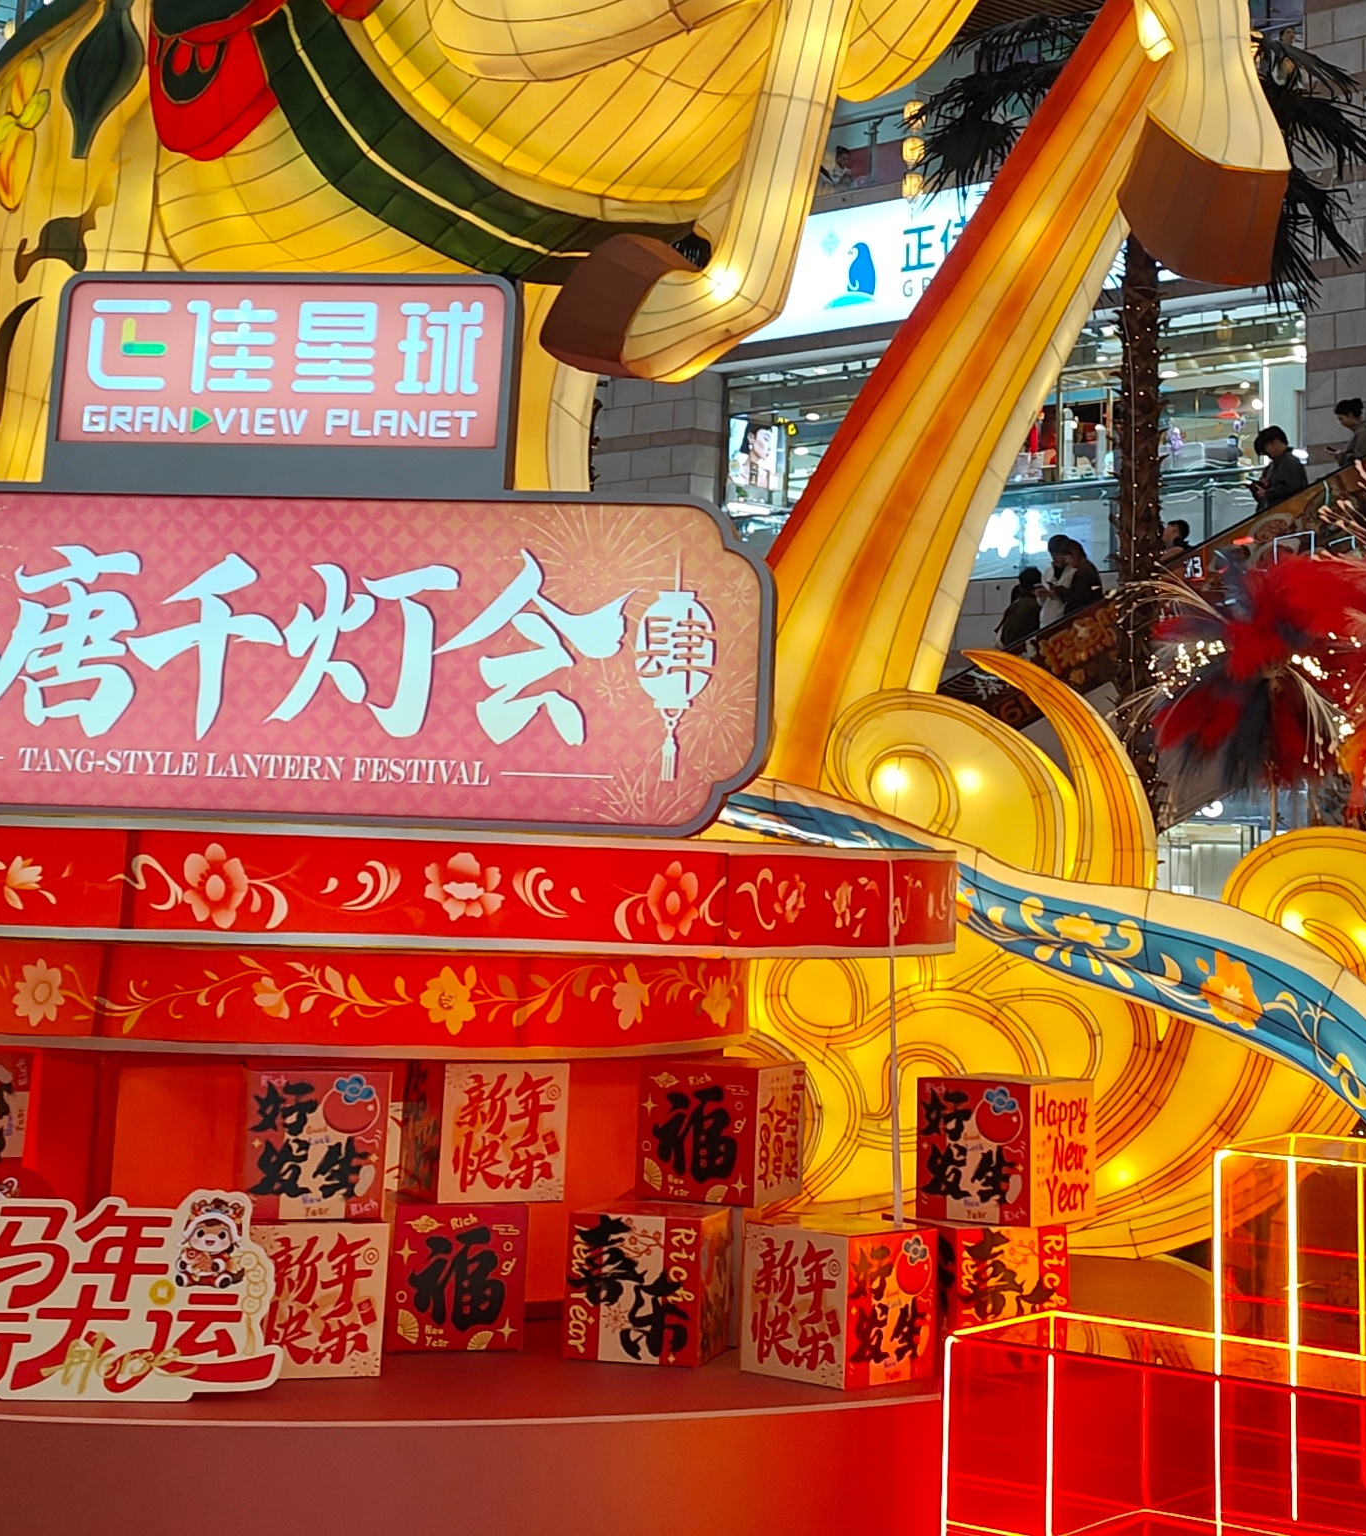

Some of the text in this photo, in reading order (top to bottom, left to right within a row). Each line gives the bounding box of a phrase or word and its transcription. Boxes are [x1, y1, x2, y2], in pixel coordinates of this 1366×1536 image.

[87, 298, 485, 395] 正佳星球
[324, 408, 479, 439] PLANET
[18, 747, 492, 787] TANG-STYLE LANTERN FESTIVAL
[250, 1081, 319, 1136] 好
[455, 1071, 556, 1147] 新年
[687, 1072, 713, 1087] Rich
[652, 1085, 738, 1184] 福
[920, 1089, 973, 1142] 好
[1035, 1089, 1089, 1137] Happy
[452, 1131, 554, 1193] 快乐
[1051, 1137, 1088, 1175] New
[449, 1213, 479, 1231] Rich
[1045, 1175, 1090, 1218] Year
[273, 1233, 373, 1324] 新年
[408, 1226, 507, 1333] 福
[666, 1226, 695, 1306] Rich
[754, 1237, 836, 1312] 新年
[1041, 1232, 1069, 1312] Rich
[40, 1331, 199, 1395] Horse
[265, 1300, 371, 1367] 快乐
[751, 1300, 841, 1371] 快乐
